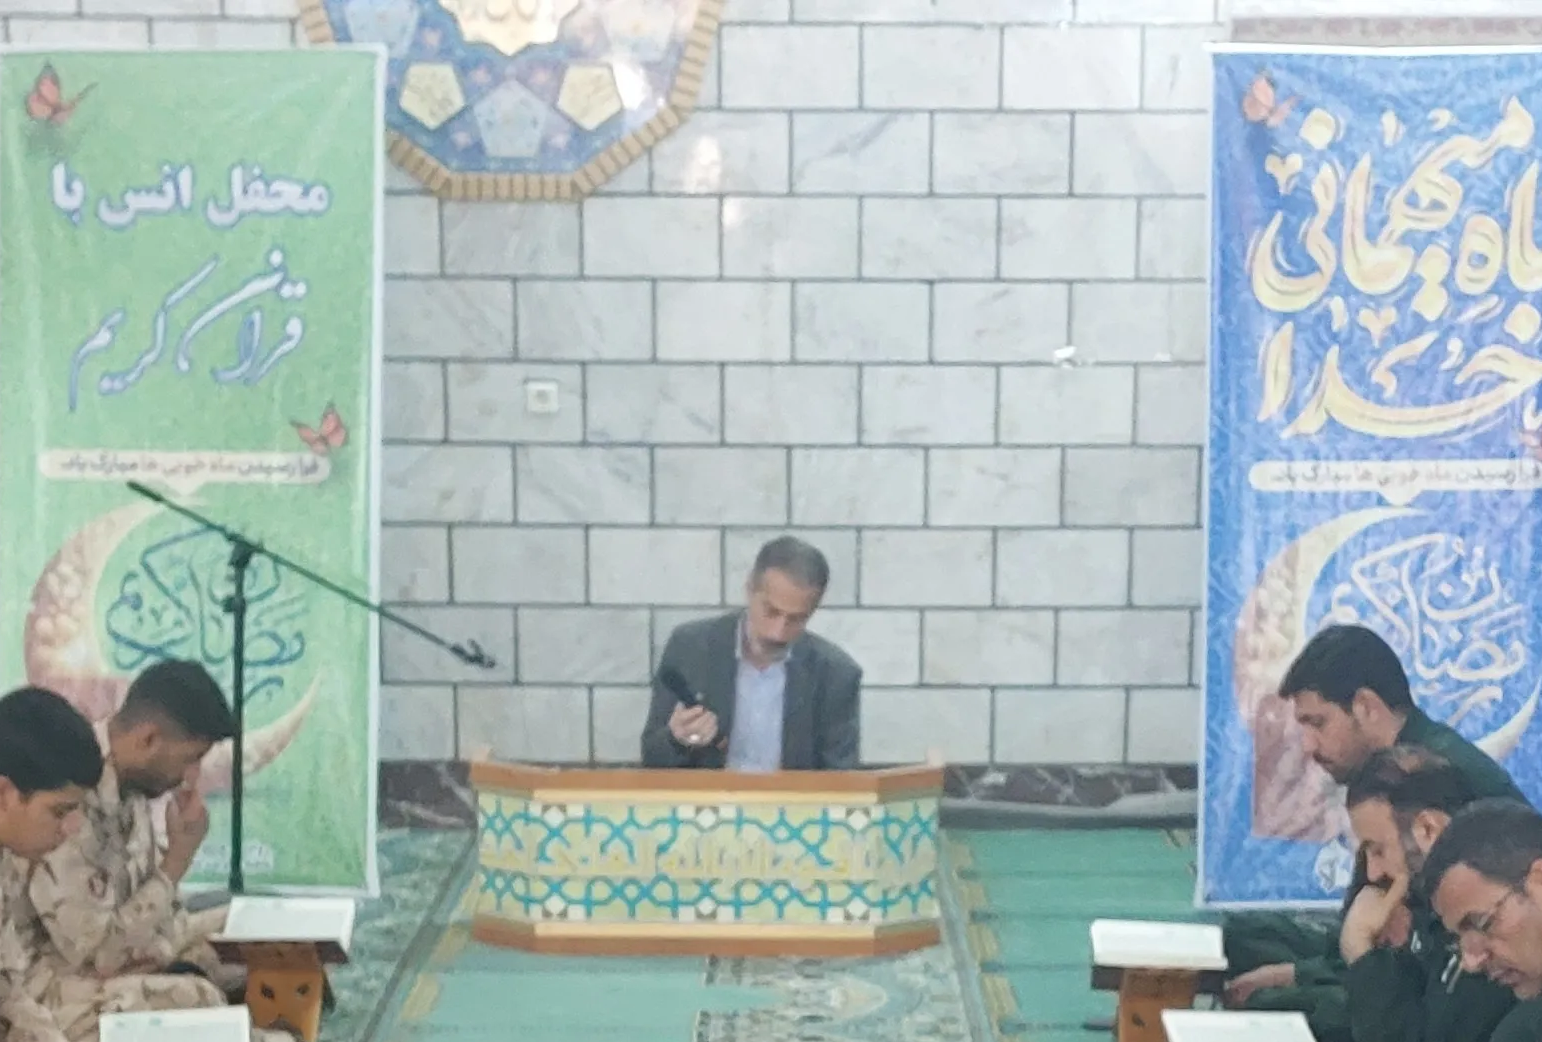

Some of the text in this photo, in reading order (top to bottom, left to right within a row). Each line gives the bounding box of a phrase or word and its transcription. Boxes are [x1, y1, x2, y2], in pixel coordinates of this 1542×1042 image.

[51, 160, 333, 232] محفل انس با
